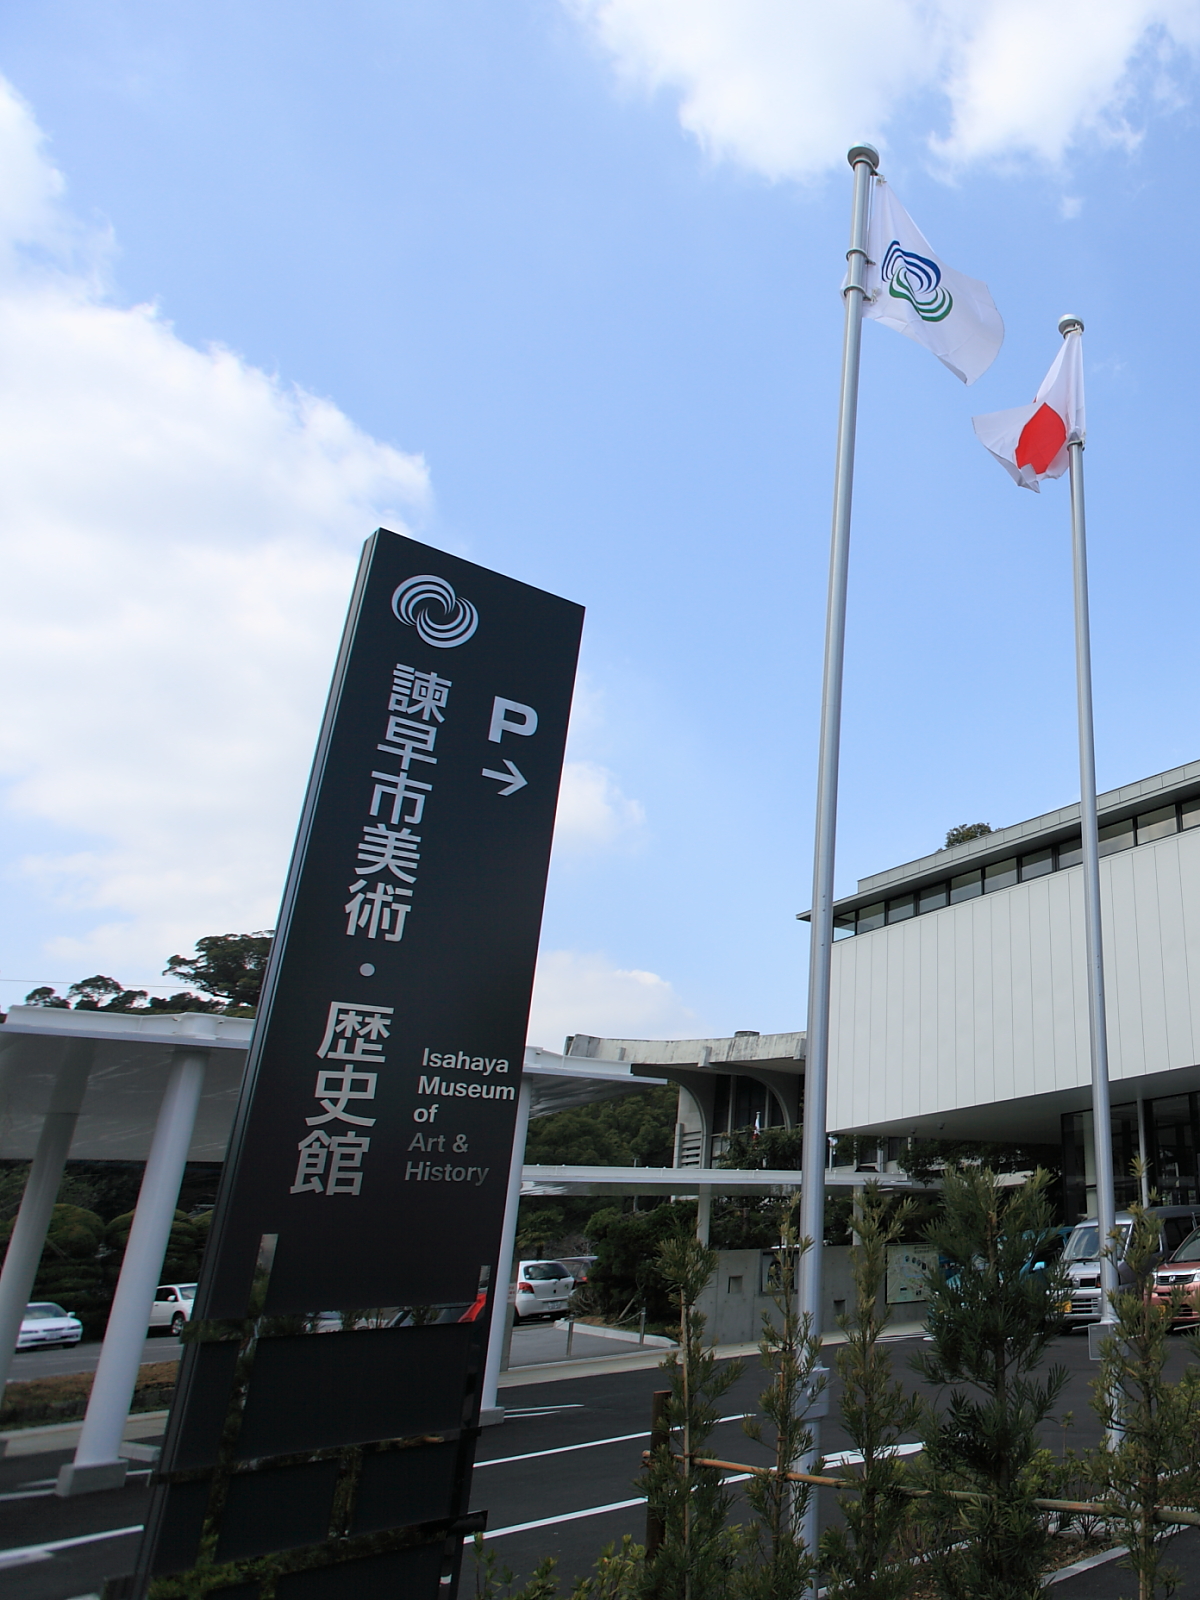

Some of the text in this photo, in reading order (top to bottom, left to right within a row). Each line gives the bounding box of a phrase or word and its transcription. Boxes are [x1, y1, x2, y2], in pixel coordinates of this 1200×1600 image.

[487, 695, 538, 744] P
[290, 663, 452, 1196] 諫早市美術・歴史館
[422, 1047, 510, 1075] Isahaya
[418, 1075, 516, 1100] Museum
[413, 1104, 438, 1123] of
[407, 1132, 469, 1153] Art &
[404, 1161, 490, 1187] History
